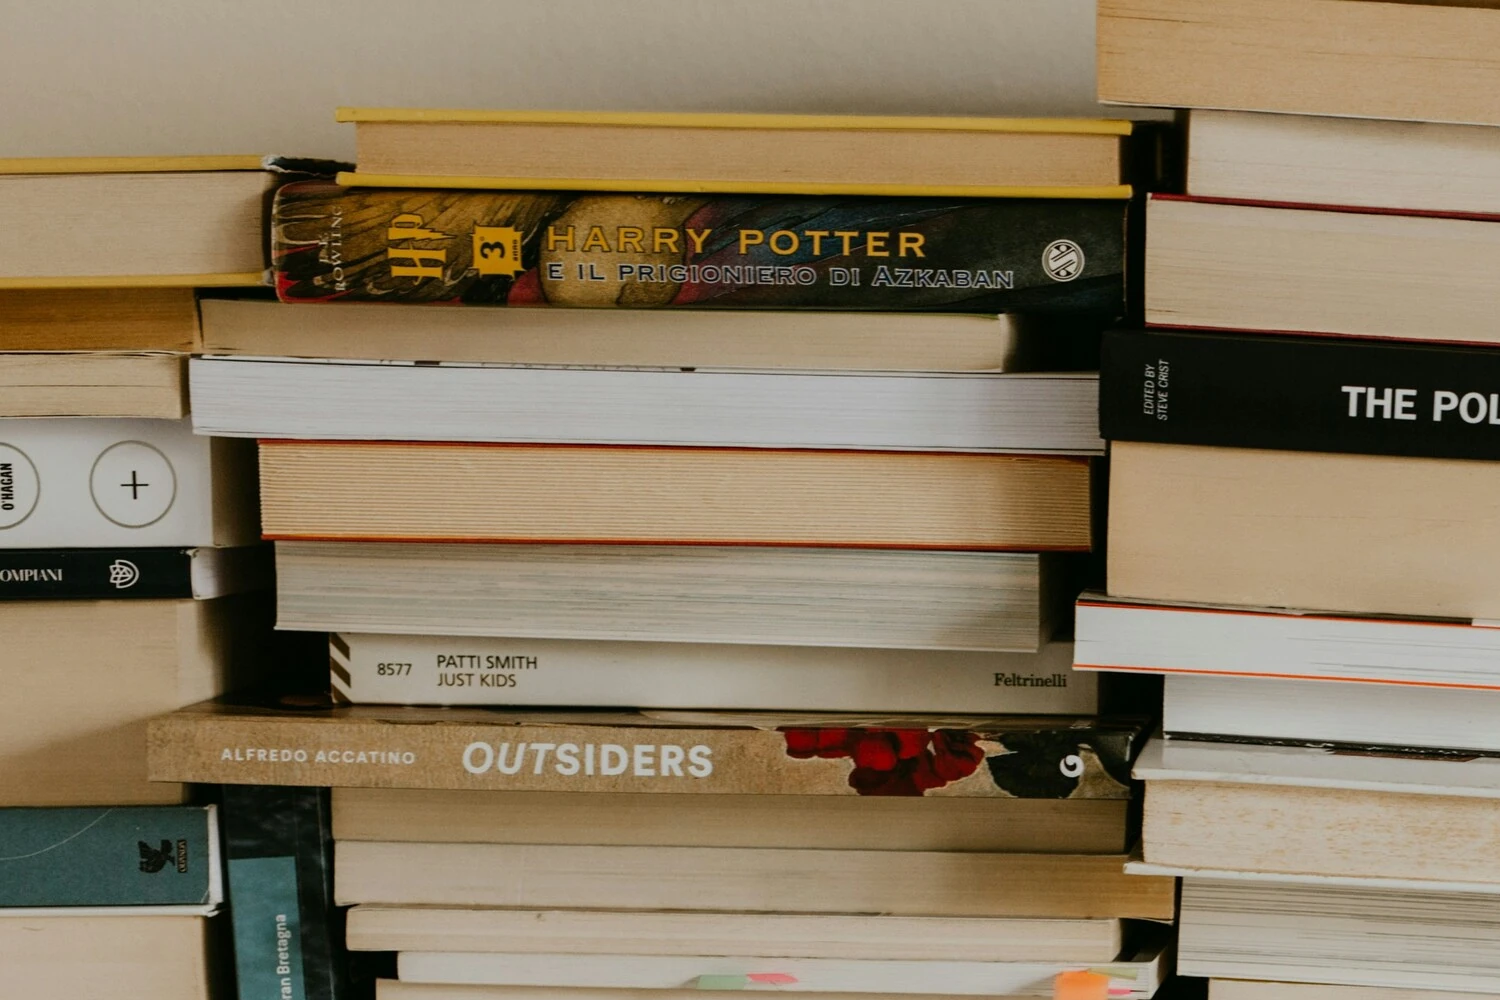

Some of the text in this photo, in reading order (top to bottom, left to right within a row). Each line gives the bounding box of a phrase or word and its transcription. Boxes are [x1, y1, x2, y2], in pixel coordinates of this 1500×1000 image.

[547, 225, 926, 258] HARRY POTTER
[547, 262, 563, 280] E
[578, 263, 605, 281] IL
[618, 263, 817, 286] PRIGIONIERO
[829, 267, 860, 286] DI
[1143, 364, 1156, 415] EDITED BY
[1157, 359, 1169, 420] STEVE CRIST
[1341, 385, 1417, 420] THE
[0, 463, 15, 511] O'HAGAN
[377, 663, 412, 676] 8577
[436, 655, 538, 670] PATTI SMITH
[436, 673, 516, 688] JUST KIDS
[994, 672, 1067, 688] Feltrinelli
[221, 747, 415, 765] ALFREDO ACCATINO
[461, 741, 714, 778] OUTSIDERS
[276, 914, 292, 974] Bretagna
